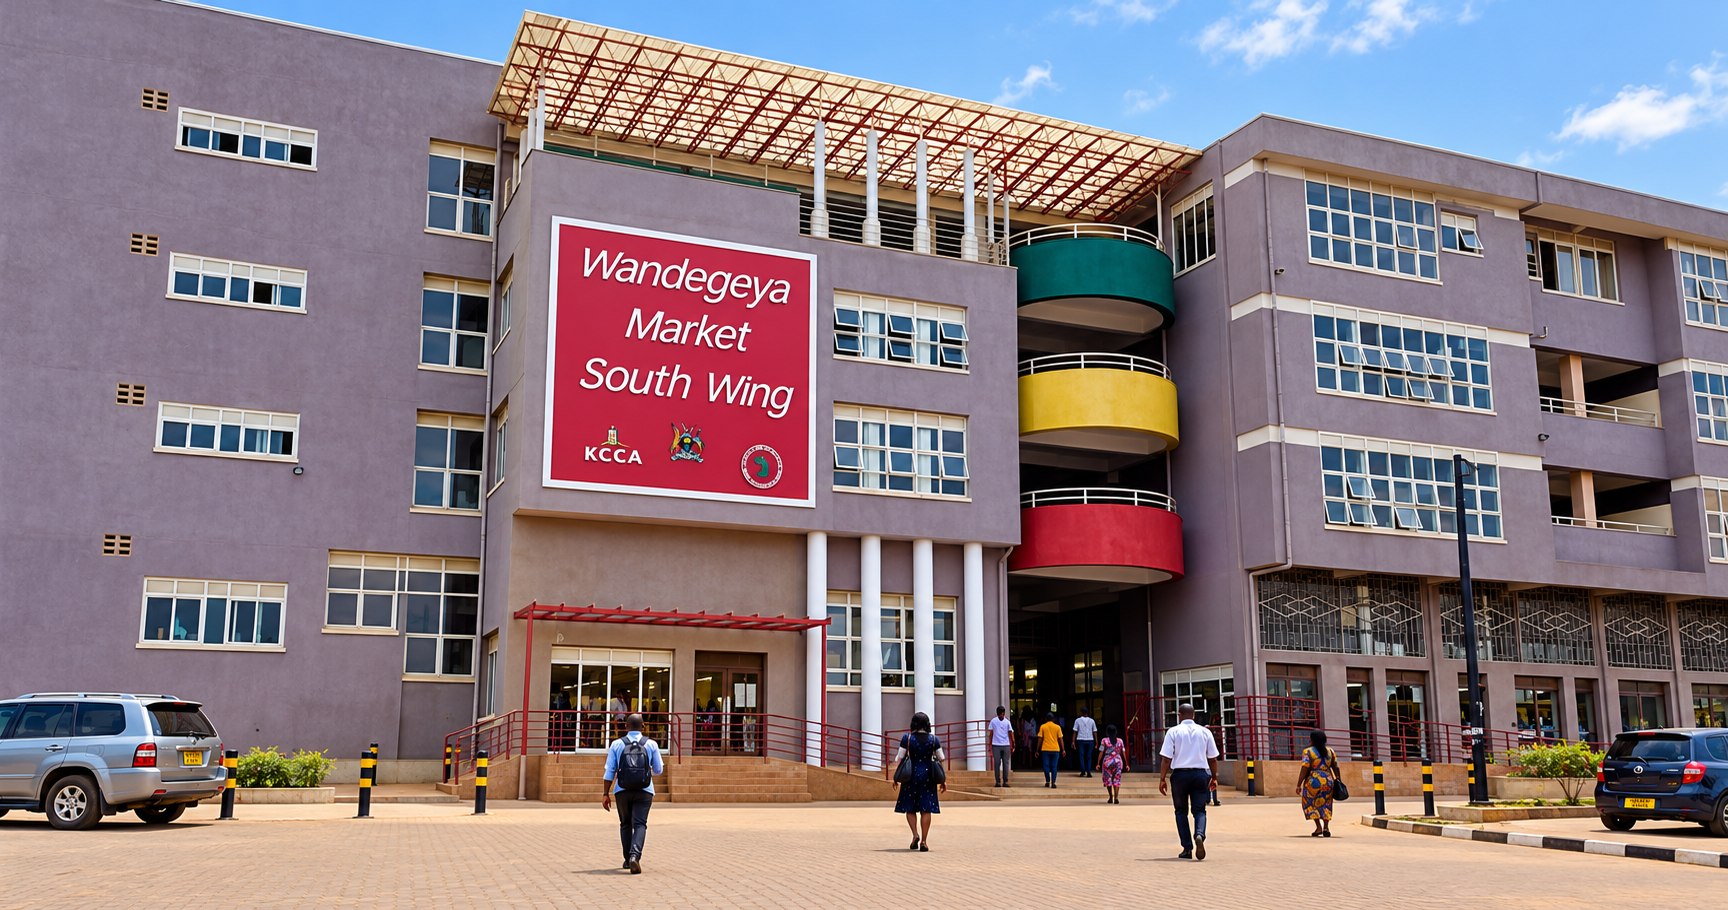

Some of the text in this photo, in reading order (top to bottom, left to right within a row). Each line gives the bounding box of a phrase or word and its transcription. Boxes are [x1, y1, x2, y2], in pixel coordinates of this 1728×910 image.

[583, 247, 791, 309] Wandegeya
[624, 307, 752, 352] Market
[579, 357, 795, 419] South Wing
[584, 446, 643, 465] KCCA
